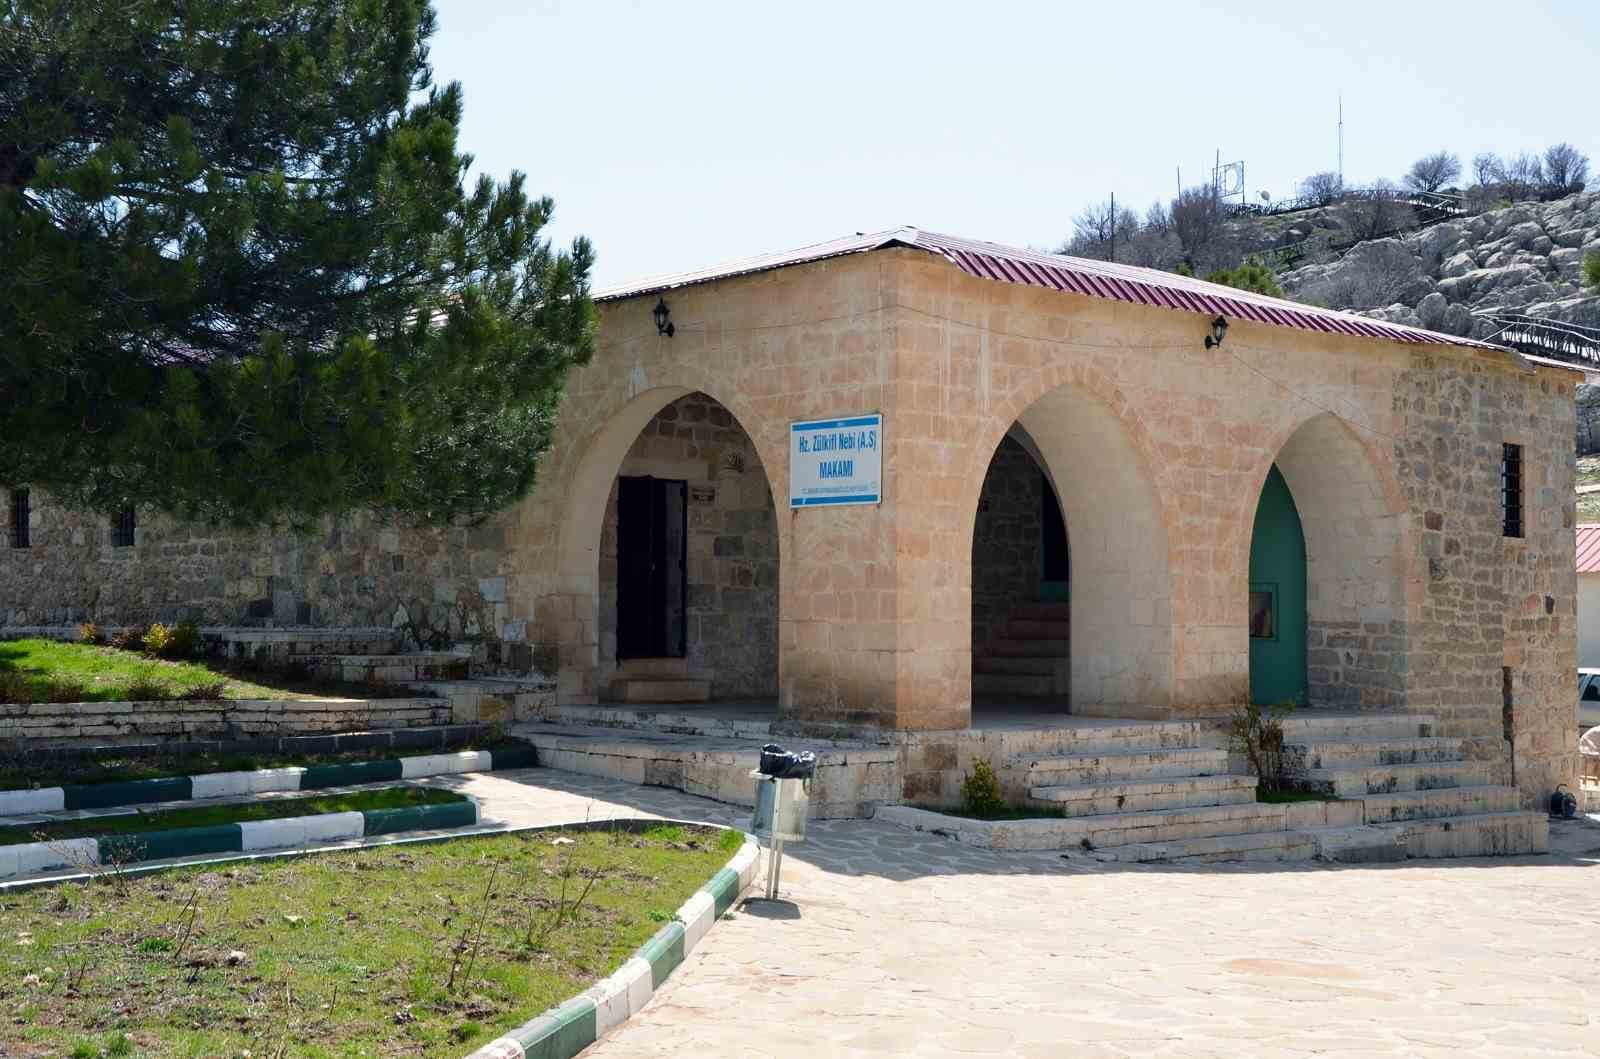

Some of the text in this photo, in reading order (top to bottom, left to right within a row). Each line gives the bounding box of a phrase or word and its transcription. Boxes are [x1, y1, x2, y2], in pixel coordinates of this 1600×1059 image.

[799, 436, 811, 453] Hz.
[839, 432, 856, 450] Nebi
[819, 460, 853, 479] MAKAMI
